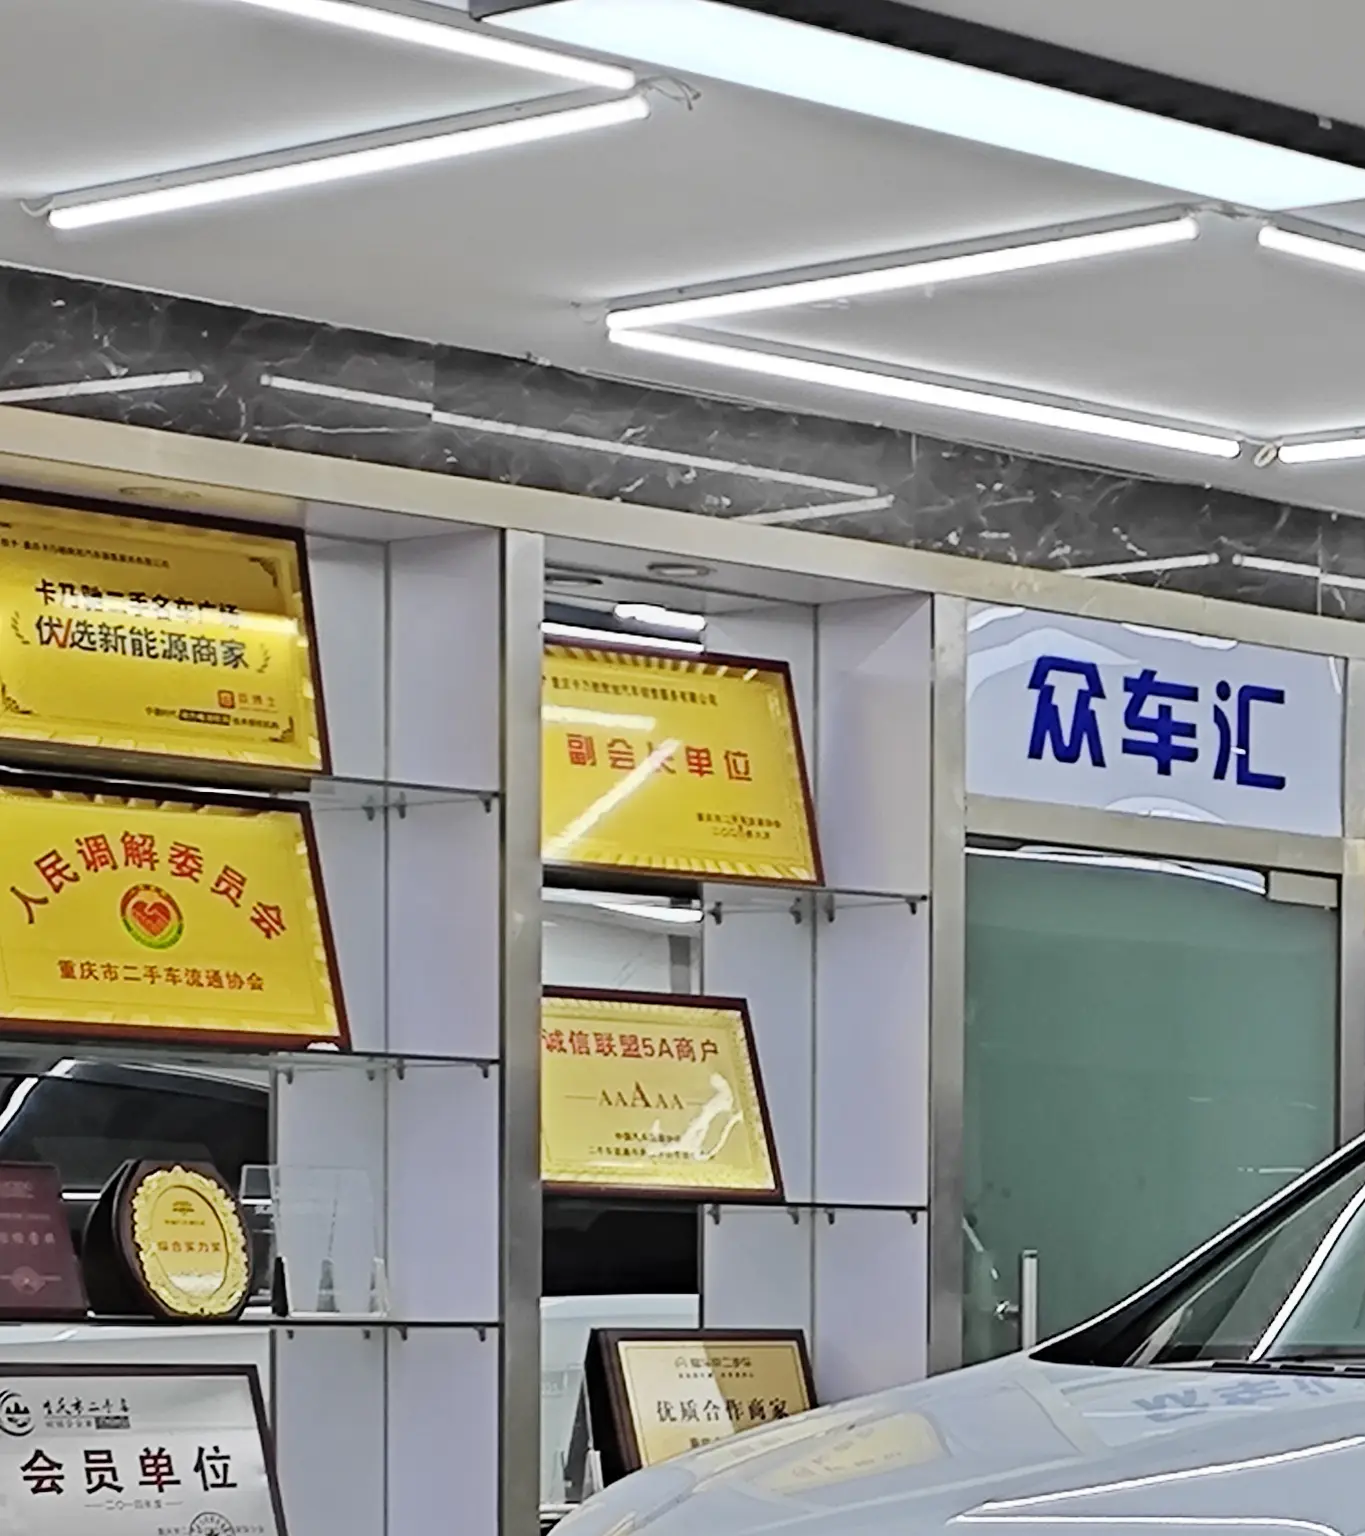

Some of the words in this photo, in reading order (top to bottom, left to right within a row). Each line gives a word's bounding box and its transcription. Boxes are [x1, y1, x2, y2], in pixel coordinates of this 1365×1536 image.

[35, 615, 249, 669] 优选新能源商家
[1027, 655, 1286, 790] 众车汇
[10, 830, 288, 940] 人民调解委员会
[57, 959, 265, 991] 重庆市二手车流通协会
[541, 1028, 719, 1063] 诚信联盟5A商户
[656, 1397, 791, 1422] 优质合作商家
[20, 1445, 238, 1495] 会员单位
